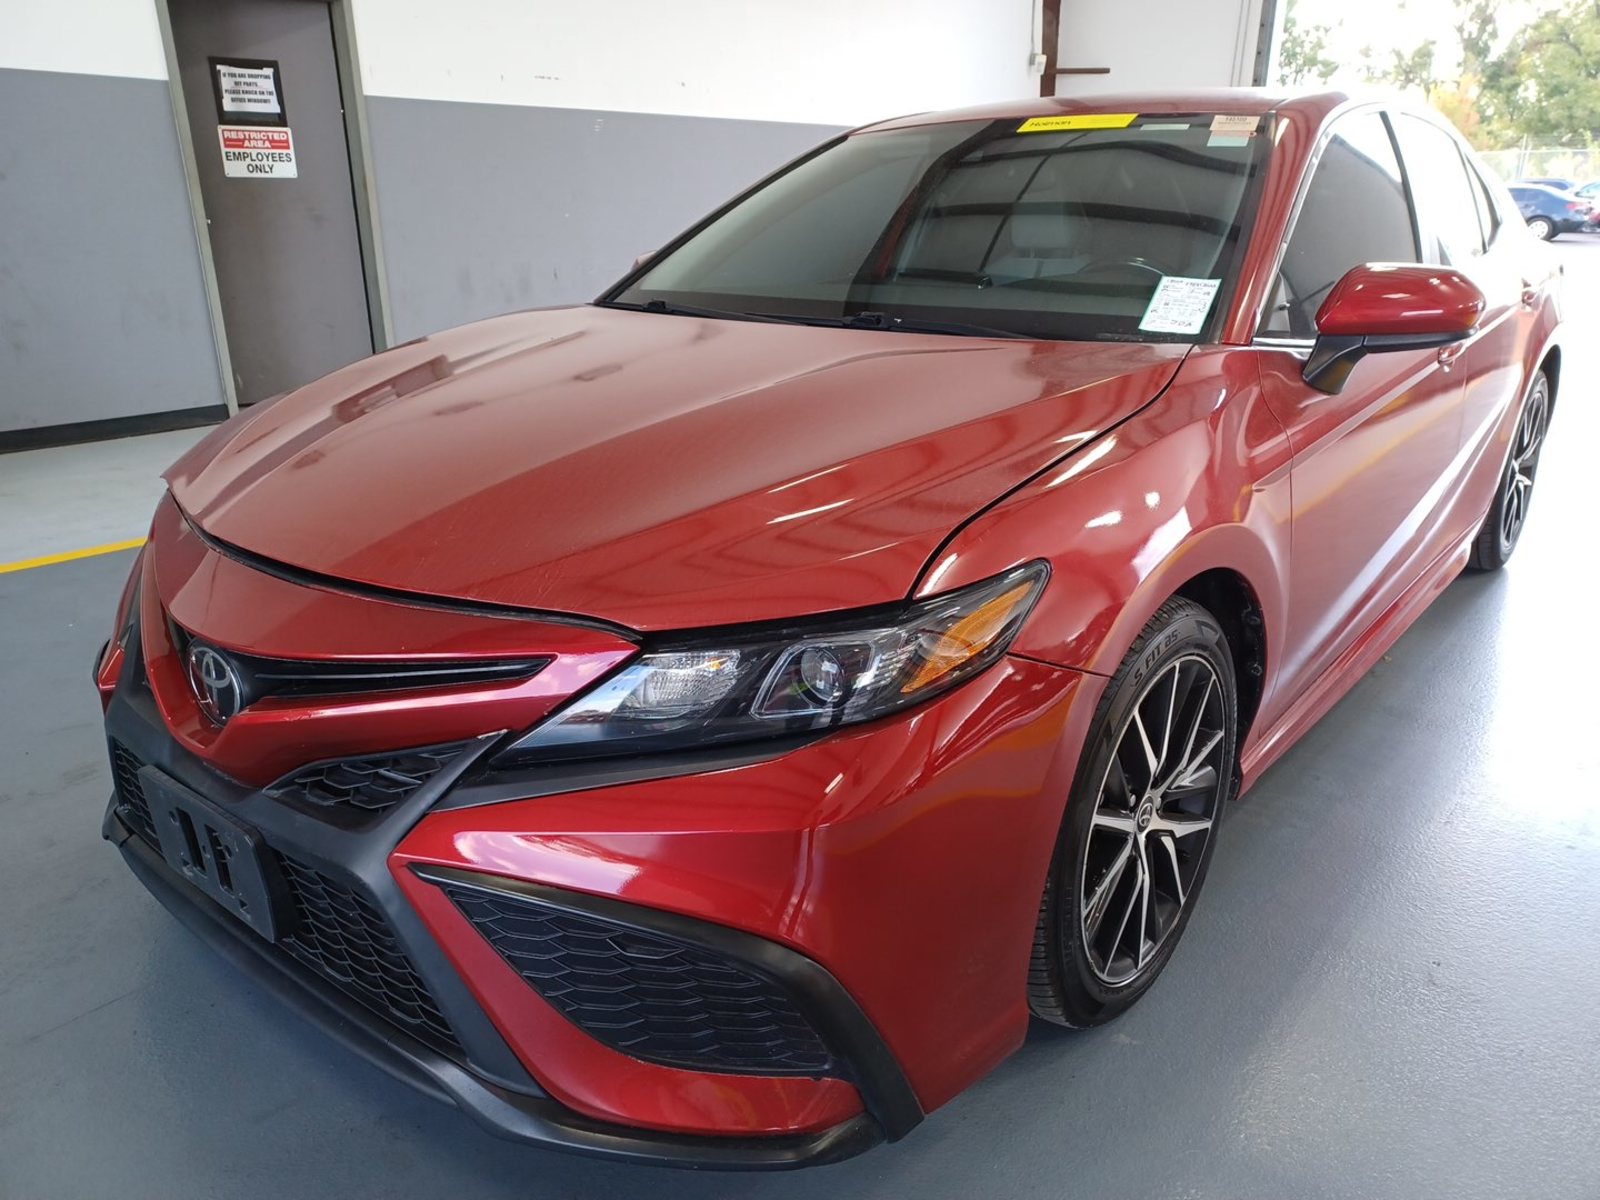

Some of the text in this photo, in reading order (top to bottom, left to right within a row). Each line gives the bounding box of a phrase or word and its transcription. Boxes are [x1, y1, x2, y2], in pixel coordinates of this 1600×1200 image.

[223, 131, 287, 140] RESTRICTED
[243, 140, 272, 149] AREA
[225, 151, 292, 162] EMPLOYEES
[246, 163, 275, 174] ONLY
